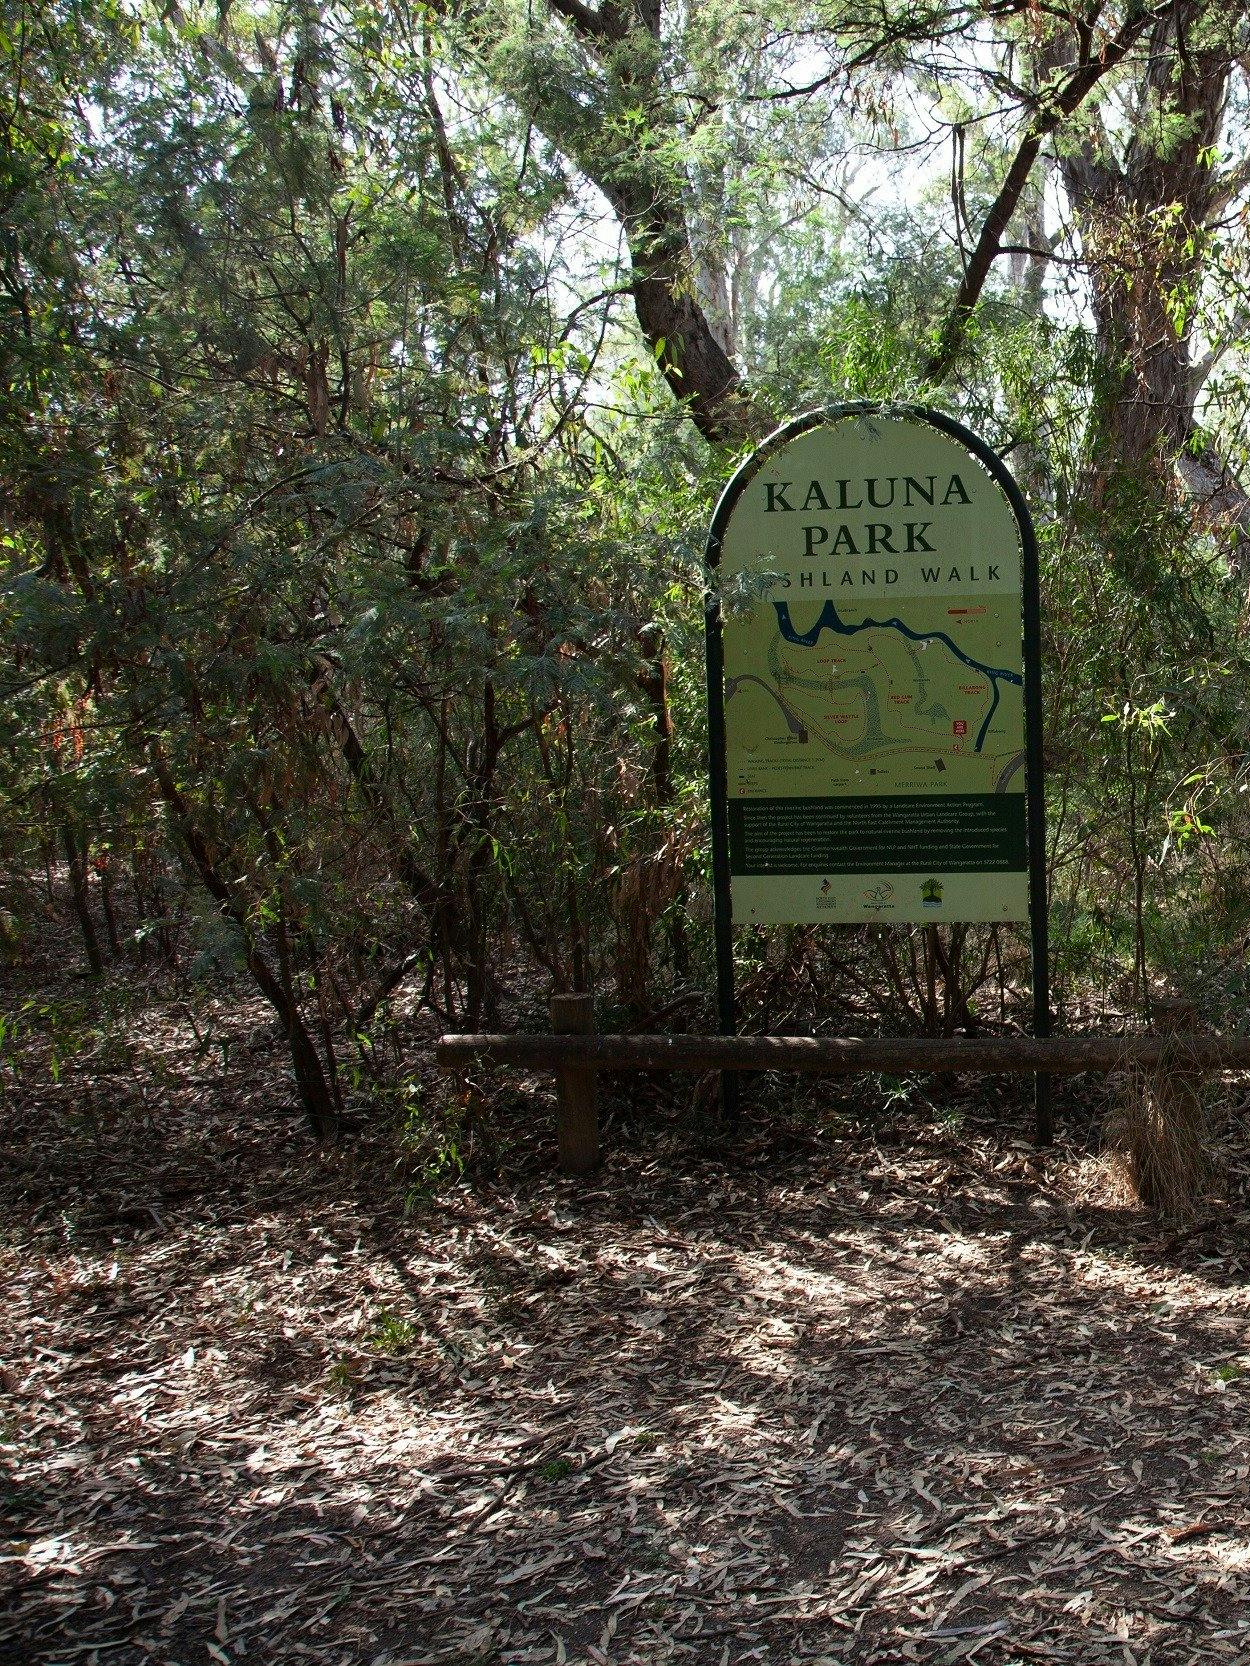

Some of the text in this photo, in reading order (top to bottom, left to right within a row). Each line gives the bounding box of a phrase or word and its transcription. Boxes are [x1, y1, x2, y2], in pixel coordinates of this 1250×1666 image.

[763, 474, 974, 513] KALUNA
[802, 522, 938, 557] PARK
[746, 565, 1001, 589] SHLAND WALK
[894, 780, 948, 789] MERRIWA PARK
